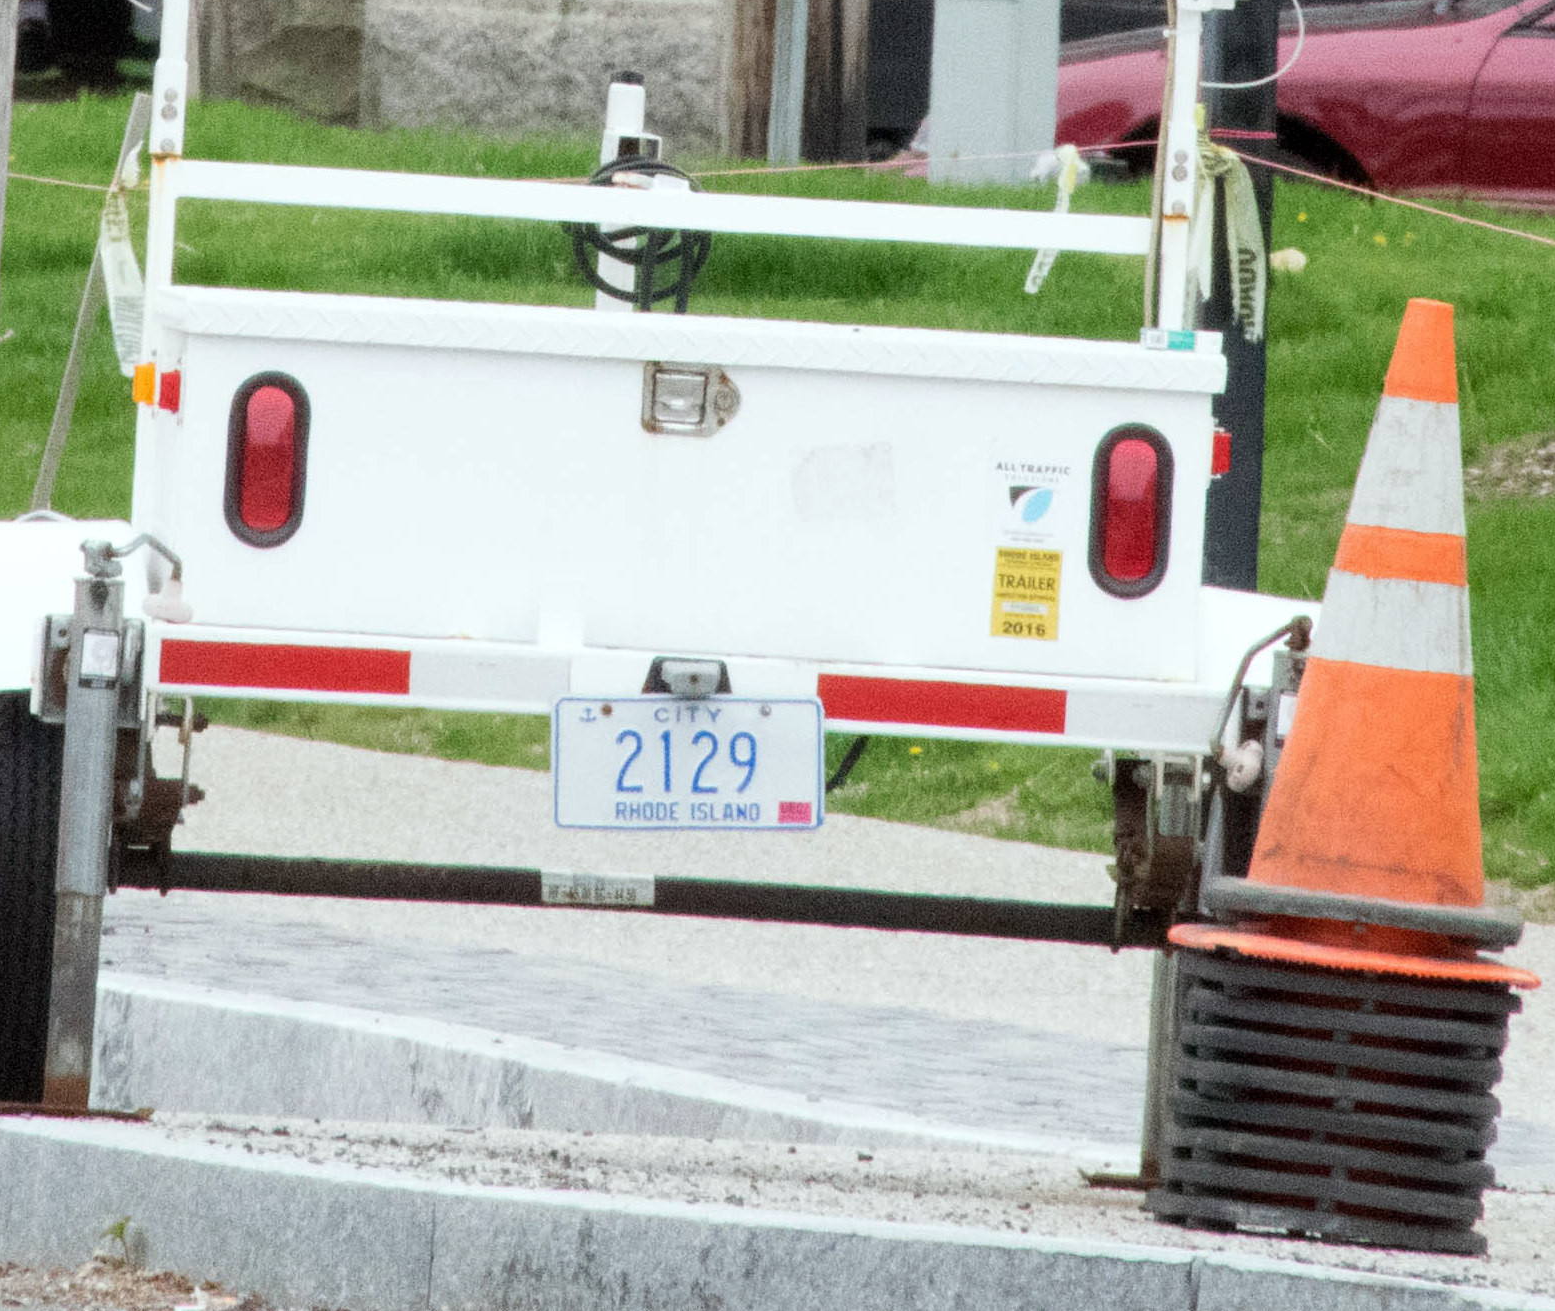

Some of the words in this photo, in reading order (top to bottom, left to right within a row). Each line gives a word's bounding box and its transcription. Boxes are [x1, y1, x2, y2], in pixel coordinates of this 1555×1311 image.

[995, 461, 1017, 472] ALL
[1021, 464, 1071, 476] TRAFFIC
[997, 573, 1056, 591] TRAILER
[1002, 620, 1047, 638] 2016
[653, 707, 722, 724] CITY
[615, 729, 758, 795] 2129
[615, 801, 679, 822] RHODE
[691, 801, 761, 823] ISLAND
